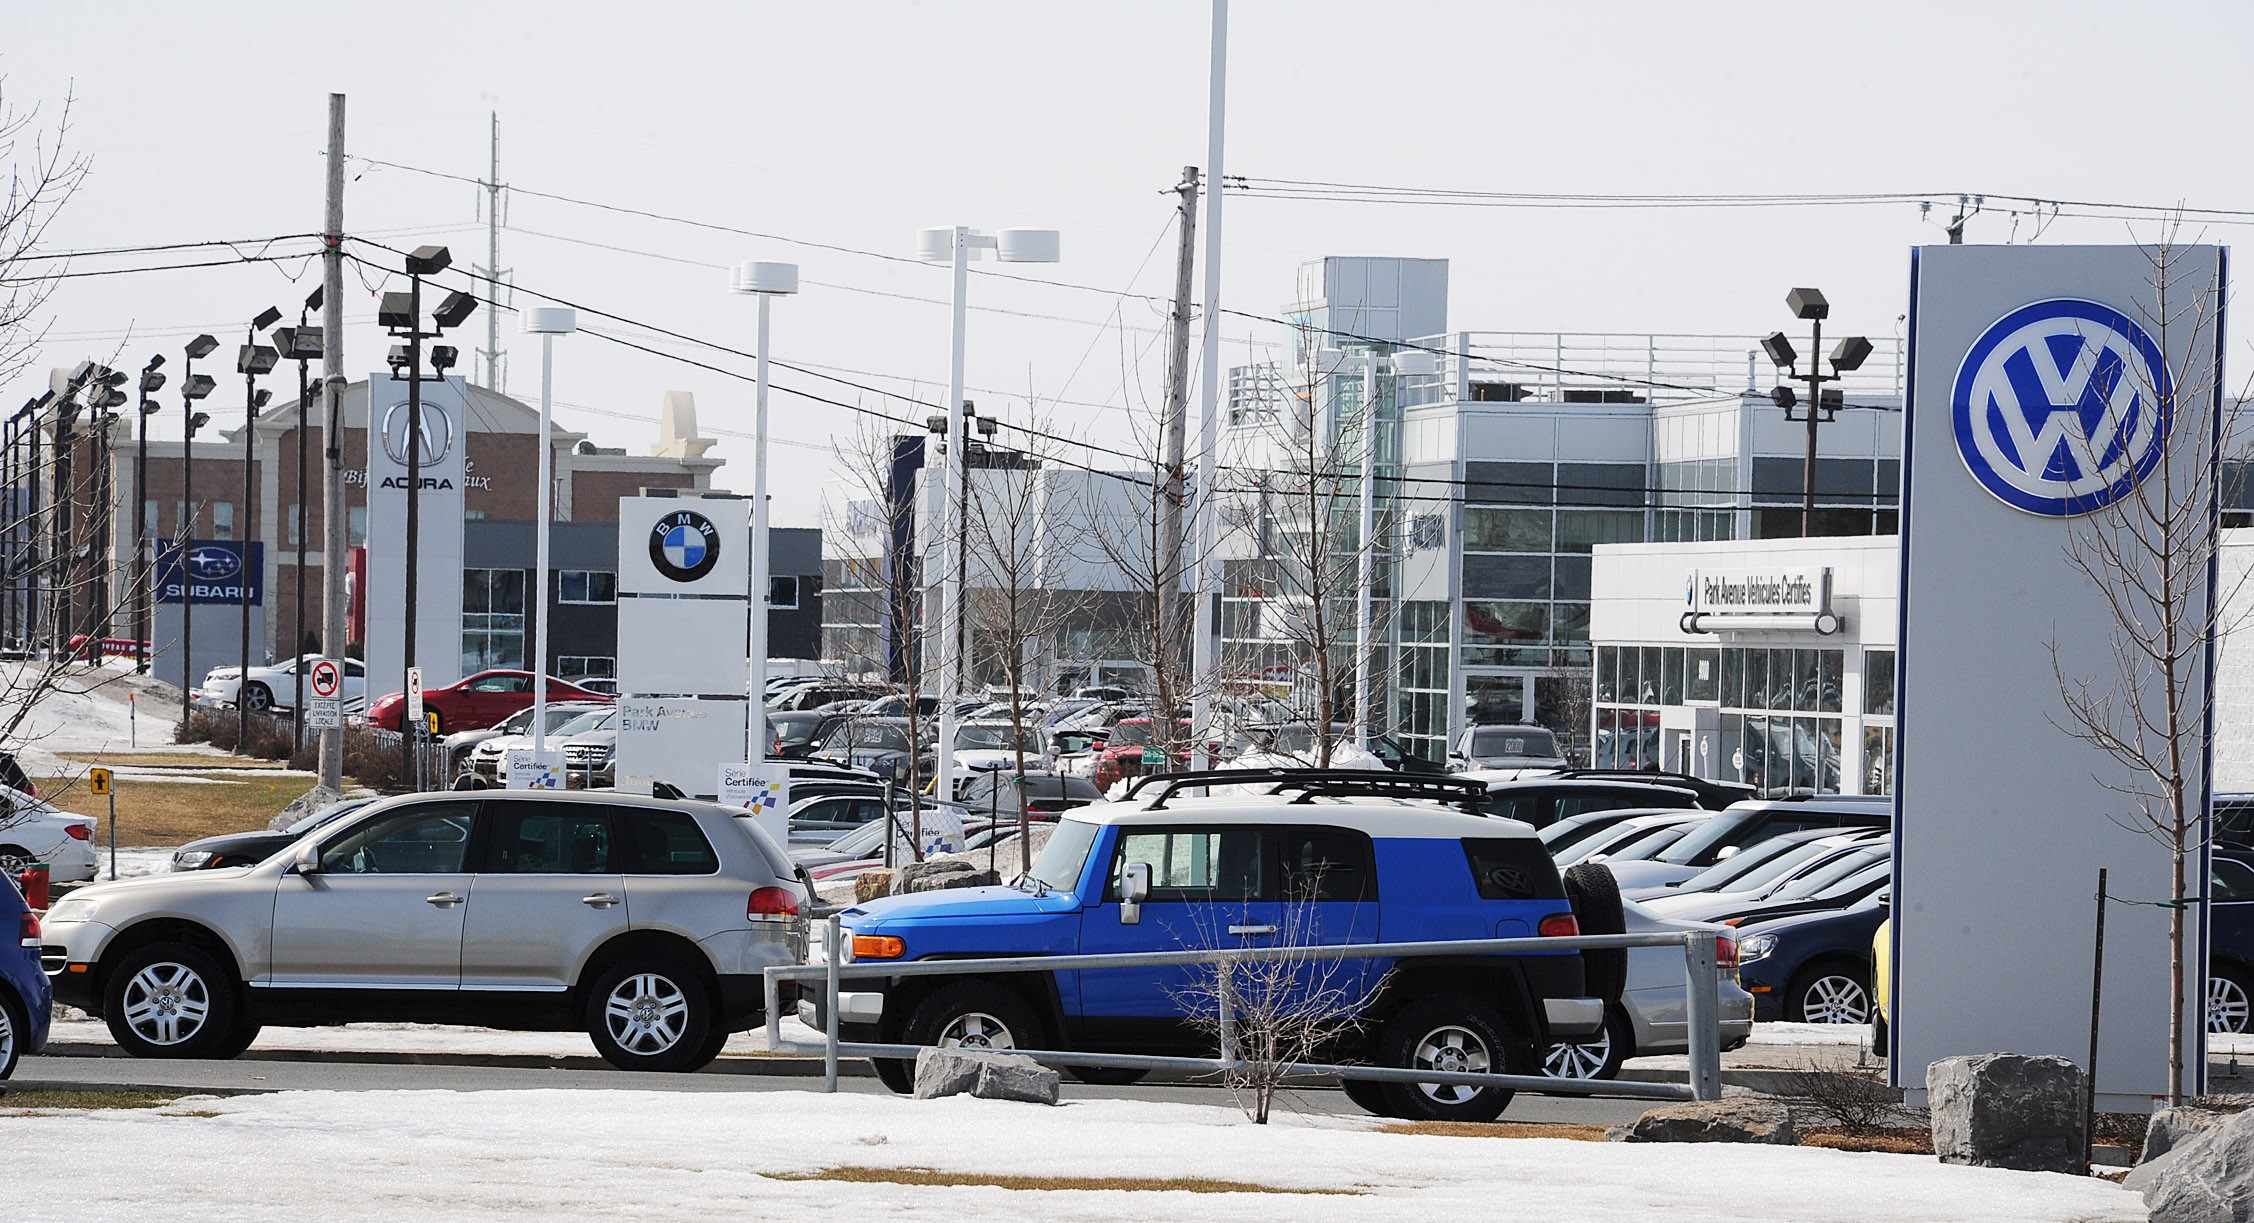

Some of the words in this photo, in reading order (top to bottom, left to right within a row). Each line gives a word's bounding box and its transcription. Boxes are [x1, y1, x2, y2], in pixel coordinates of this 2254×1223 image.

[656, 513, 714, 536] BMW
[1704, 576, 1720, 605] Park
[1720, 576, 1746, 605] Avenue
[622, 706, 653, 718] Park
[656, 706, 707, 719] Avenue
[622, 719, 660, 731] BMW
[725, 768, 746, 777] Série
[725, 777, 766, 787] Certifiée
